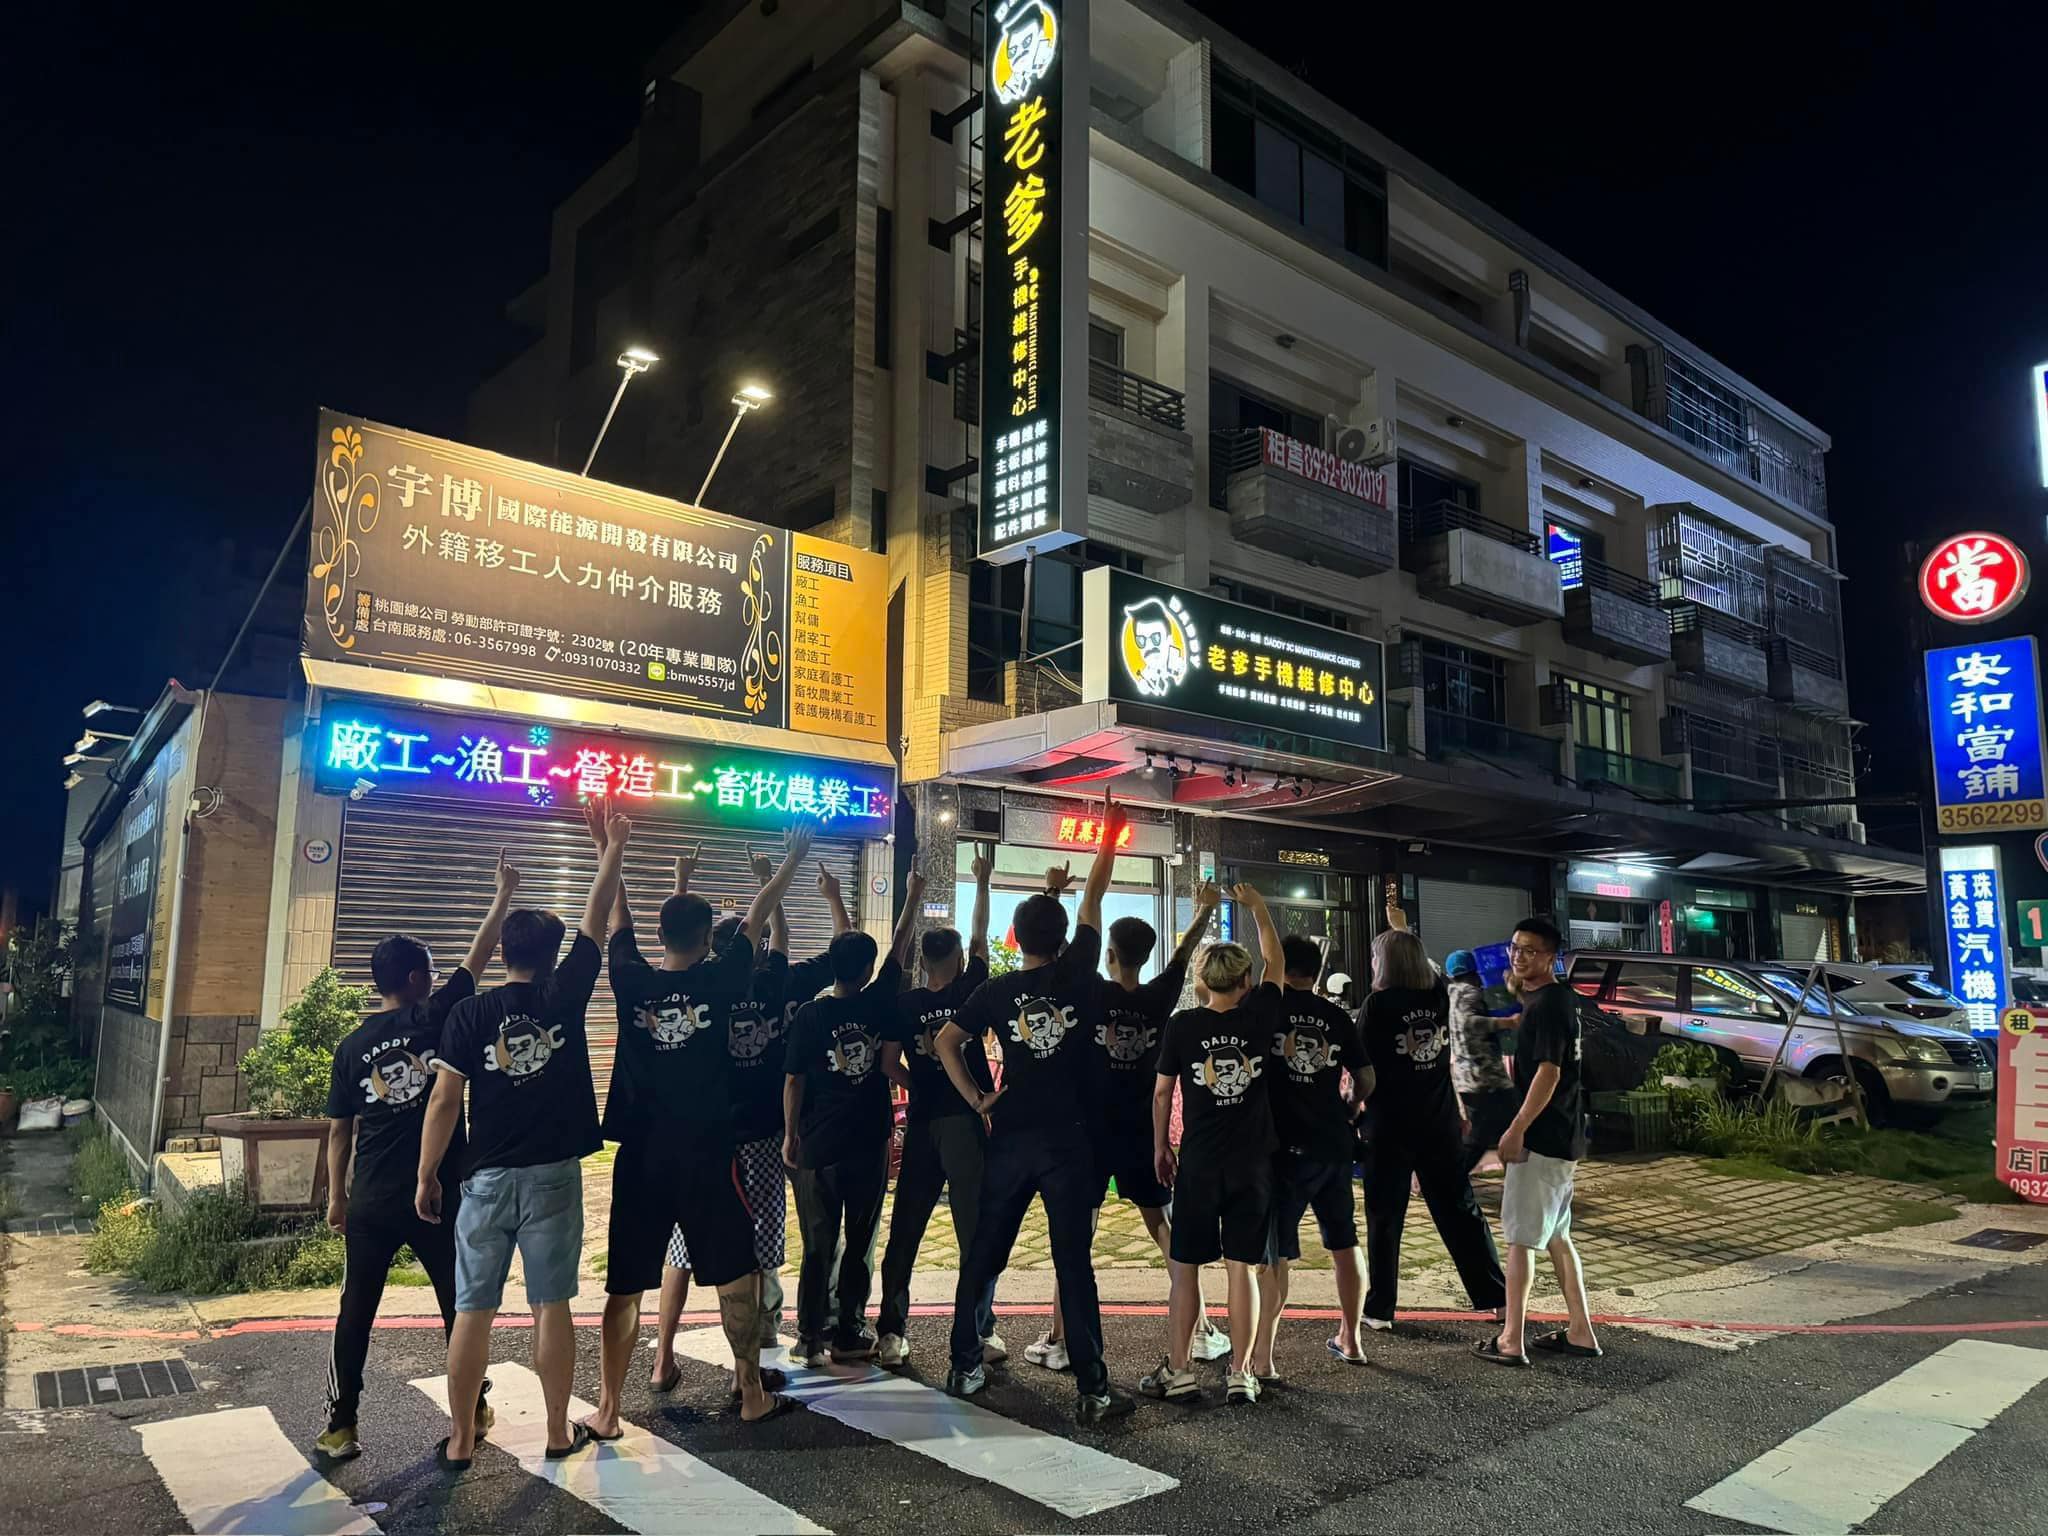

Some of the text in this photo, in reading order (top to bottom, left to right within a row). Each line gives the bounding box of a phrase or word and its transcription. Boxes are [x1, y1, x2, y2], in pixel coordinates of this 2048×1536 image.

[1003, 95, 1047, 255] 老爹
[387, 464, 738, 574] 宇博 國際能源開發有限公司
[402, 524, 723, 616] 外籍移工人力仲介服務
[797, 554, 849, 580] 服務項目
[1937, 539, 2003, 612] 當
[795, 575, 819, 591] 廠工
[795, 593, 819, 610] 漁工
[794, 629, 831, 648] 屠宰工
[572, 633, 614, 654] 2302號
[619, 640, 737, 675] (20年專業團隊)
[794, 649, 831, 666] 營造工
[794, 666, 854, 688] 家庭看護工
[1207, 645, 1374, 706] 老爹手機維修中心
[794, 684, 854, 706] 畜牧農業工
[794, 702, 877, 727] 養護機構看護工
[1941, 802, 2043, 829] 3562299
[1948, 873, 1971, 929] 黃金
[1971, 872, 1996, 928] 珠寶
[694, 1004, 711, 1029] C
[1008, 1005, 1078, 1042] 3 C
[1290, 1014, 1331, 1032] DADDY
[2010, 1014, 2030, 1031] 租
[362, 1037, 411, 1064] DADDY
[484, 1024, 566, 1071] 3 C
[1201, 1035, 1248, 1050] DADDY
[1191, 1056, 1263, 1086] 3 C
[359, 1077, 379, 1103] 3
